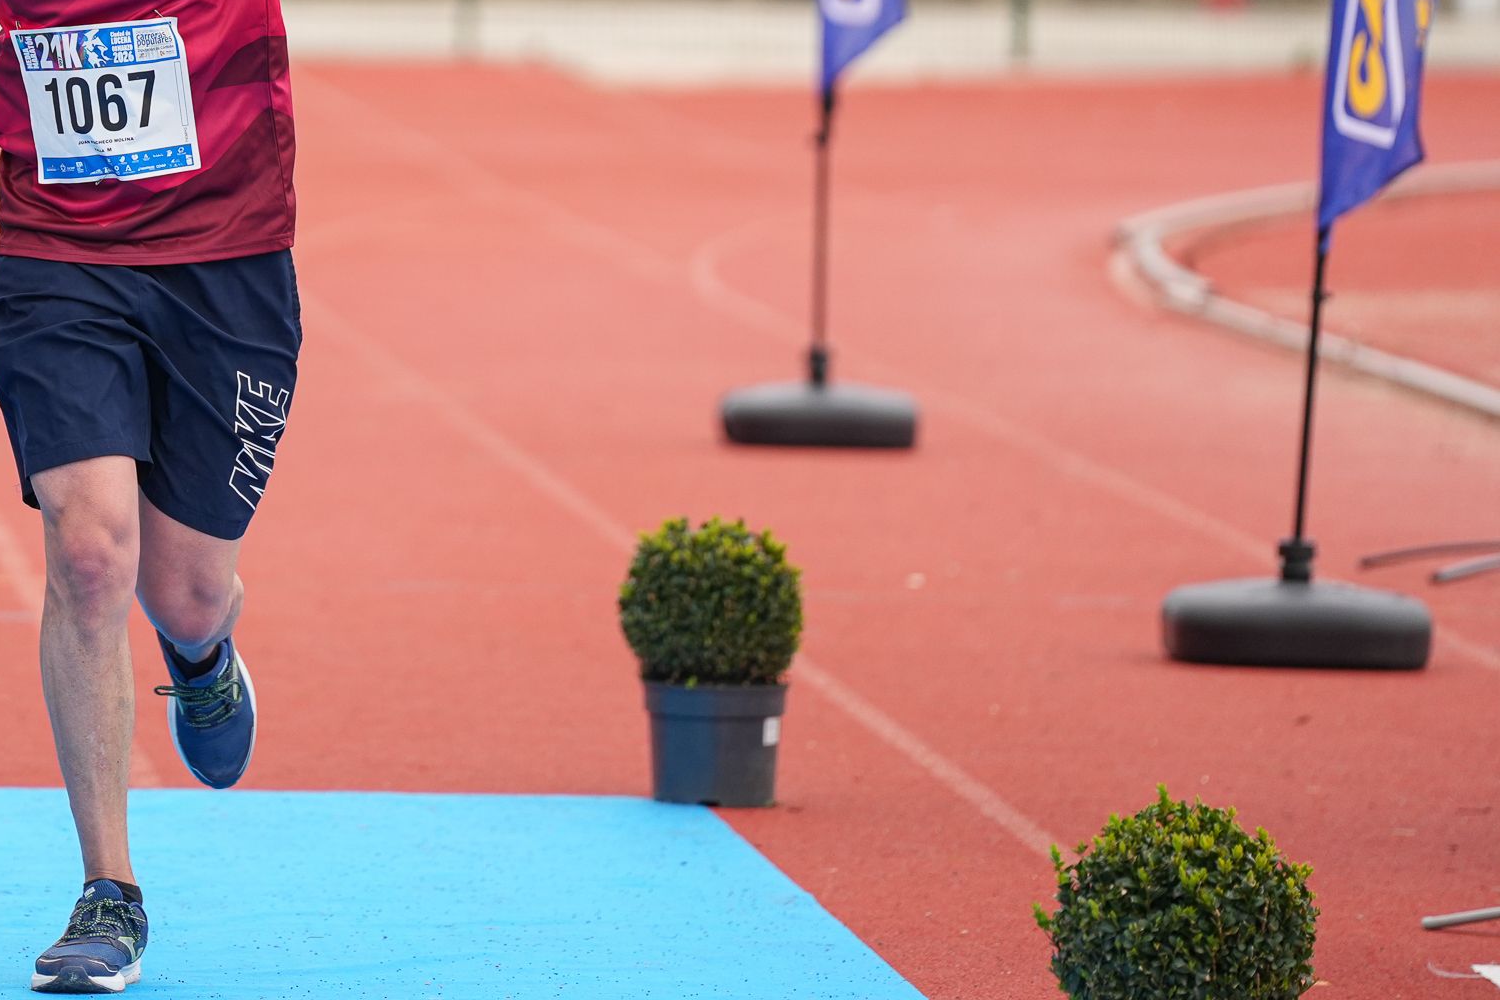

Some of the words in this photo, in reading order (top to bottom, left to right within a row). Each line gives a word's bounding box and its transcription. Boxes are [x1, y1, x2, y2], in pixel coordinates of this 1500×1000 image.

[136, 31, 166, 41] carreras
[137, 36, 173, 48] populares
[34, 32, 83, 69] 21K
[113, 51, 135, 63] 2026
[44, 70, 156, 135] 1067
[228, 370, 290, 511] NIKE
